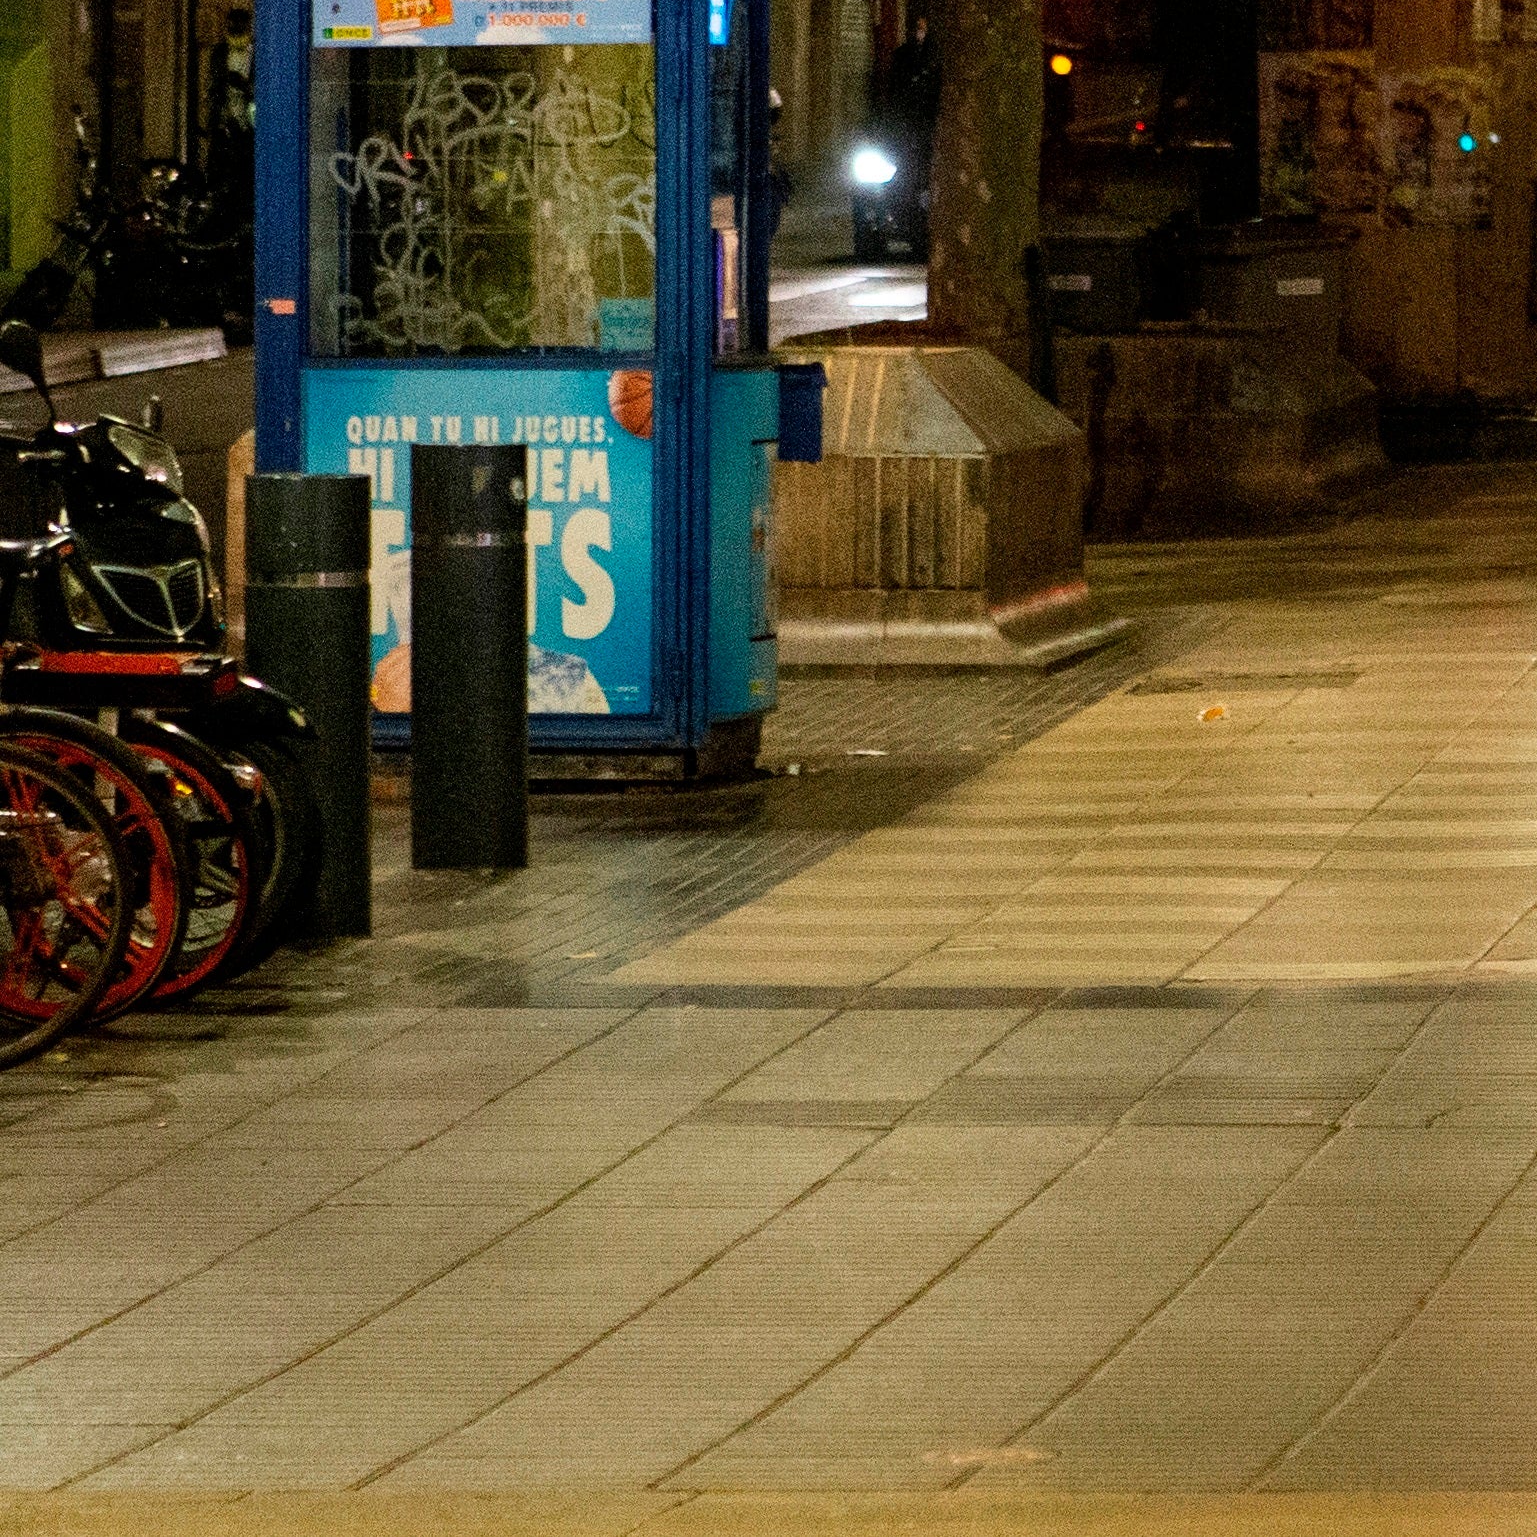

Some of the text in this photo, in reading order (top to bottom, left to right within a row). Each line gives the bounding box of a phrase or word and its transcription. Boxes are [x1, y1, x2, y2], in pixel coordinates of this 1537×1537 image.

[347, 416, 417, 444] QUAN
[431, 416, 462, 444] TU
[512, 416, 613, 445] JUGUES,
